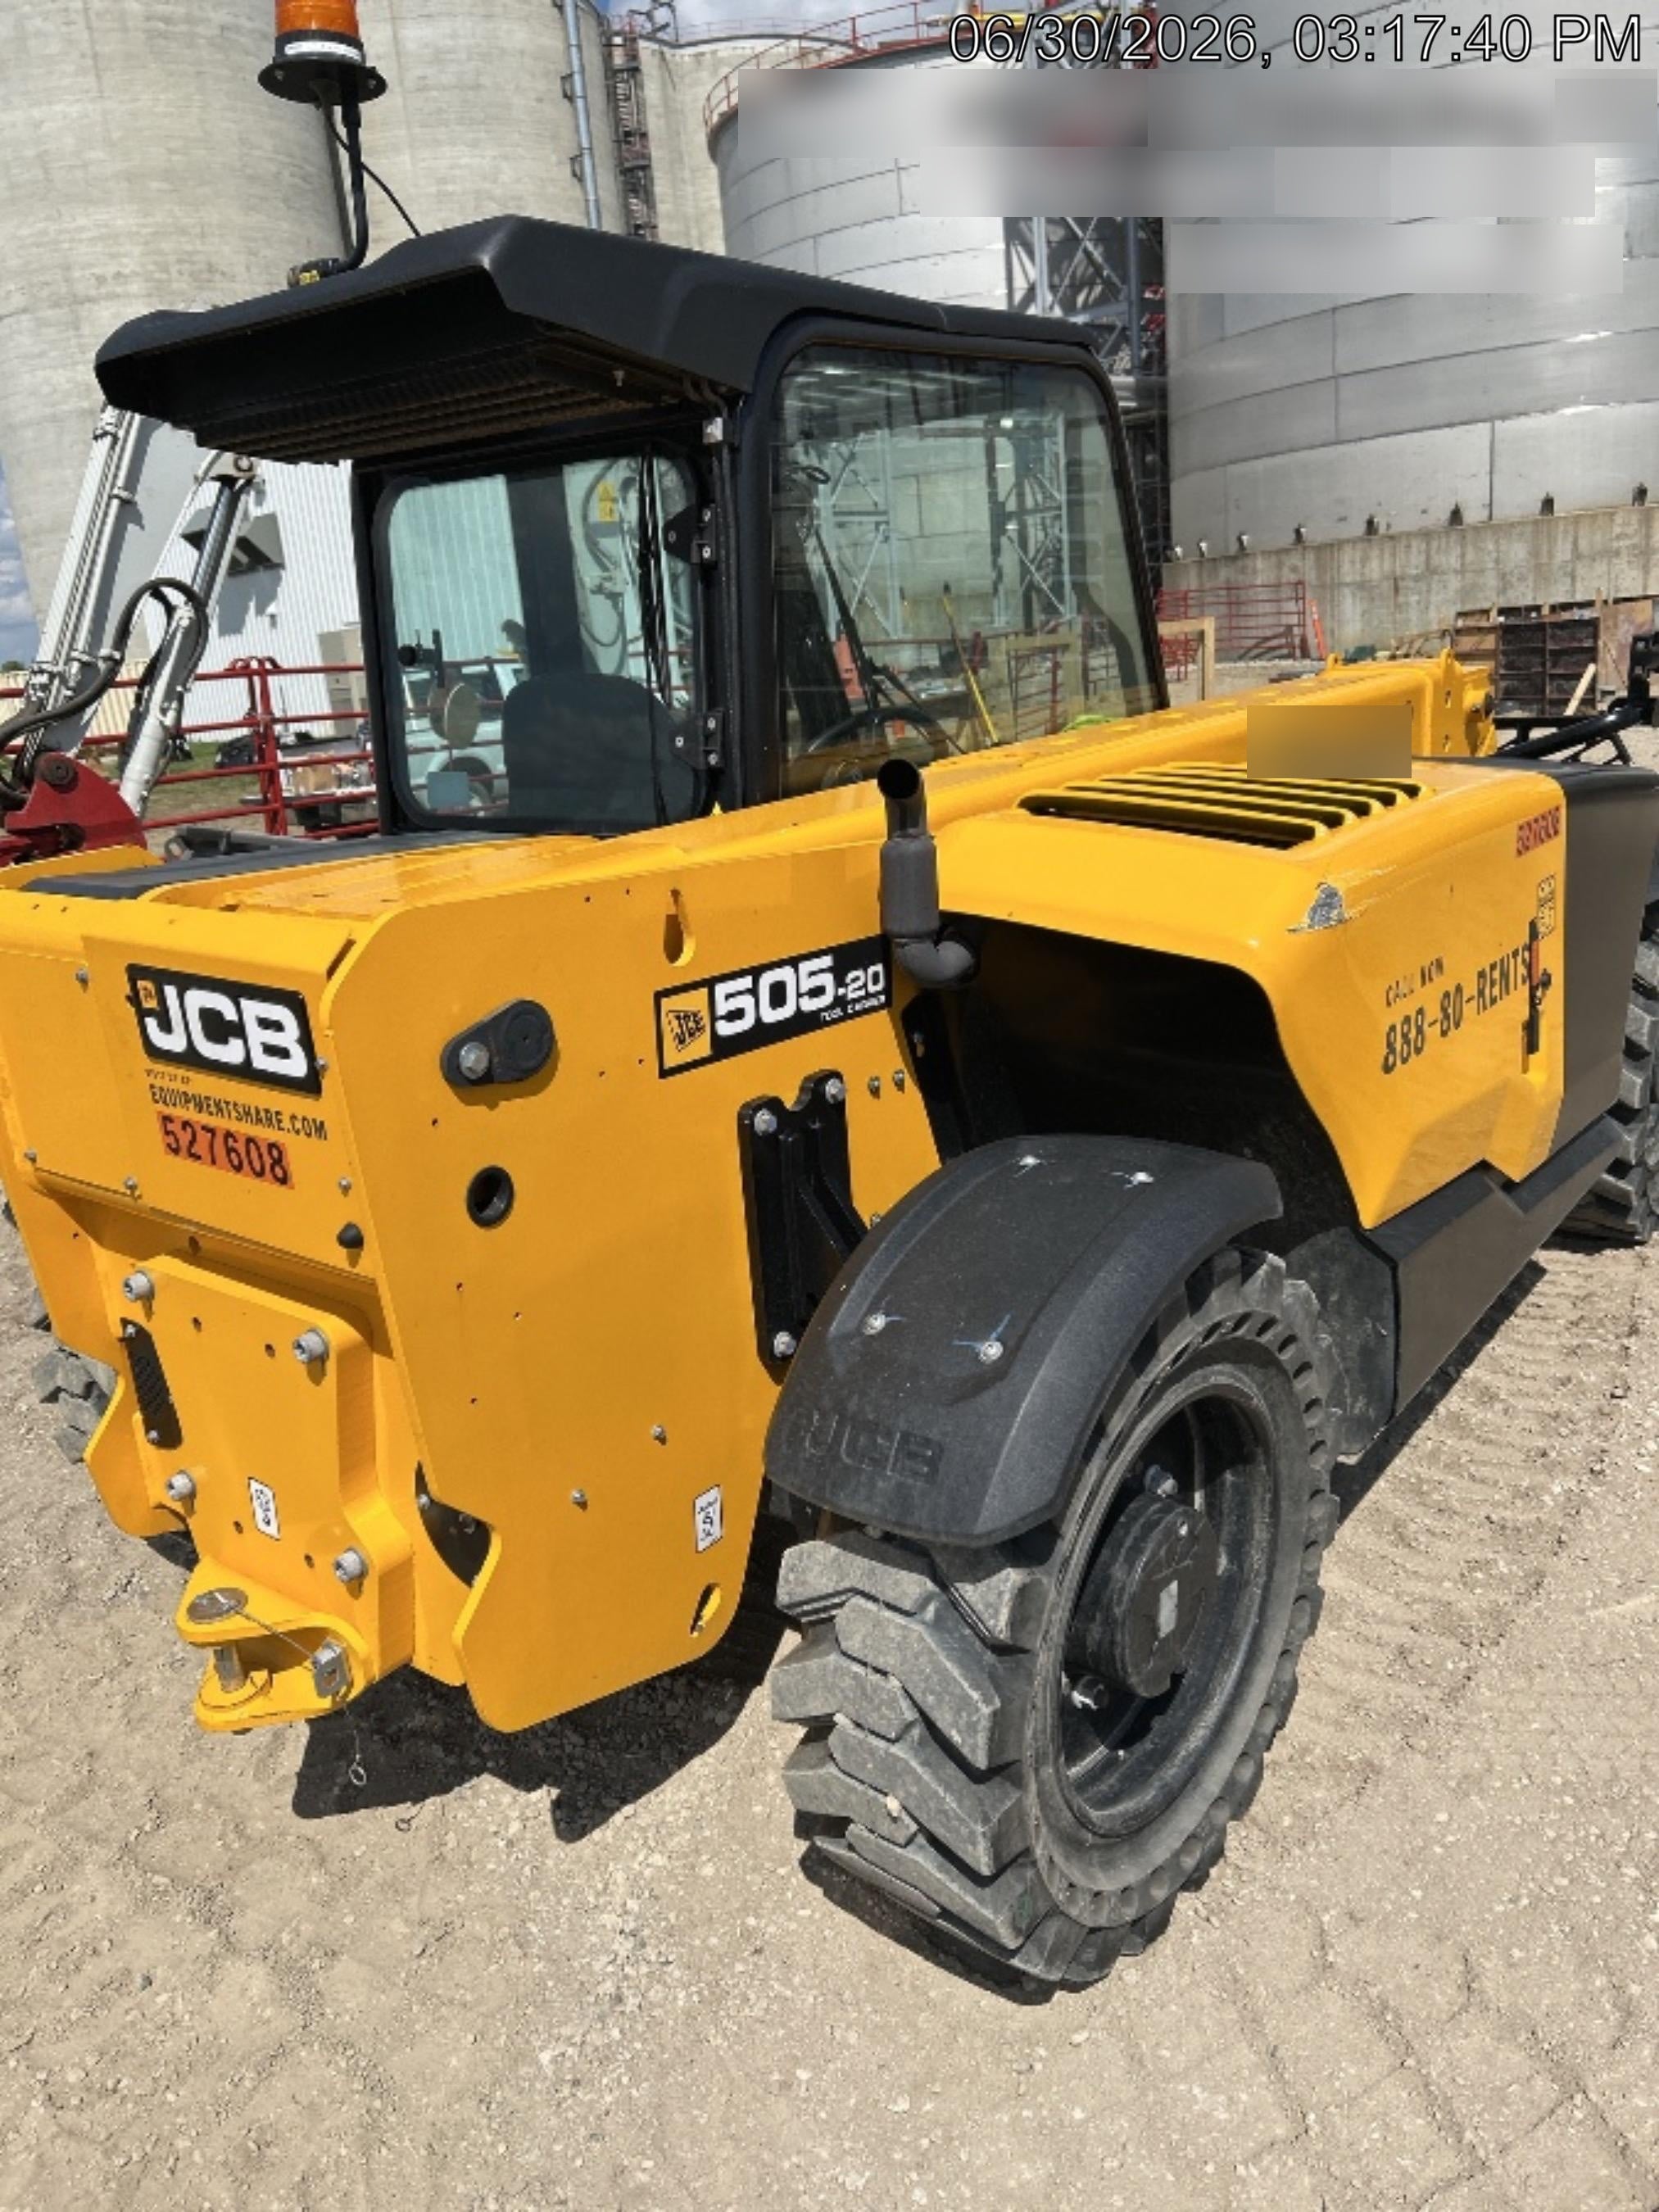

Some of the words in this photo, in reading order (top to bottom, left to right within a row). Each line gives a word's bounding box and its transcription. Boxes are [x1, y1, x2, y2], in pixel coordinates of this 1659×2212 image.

[143, 984, 308, 1078] JCB
[714, 954, 886, 1036] 505-20
[1382, 943, 1530, 1075] 888-80-RENTS
[148, 1083, 328, 1141] EQUIPMENTSHARE.COM
[161, 1114, 289, 1186] 527608
[802, 1410, 945, 1485] JCB
